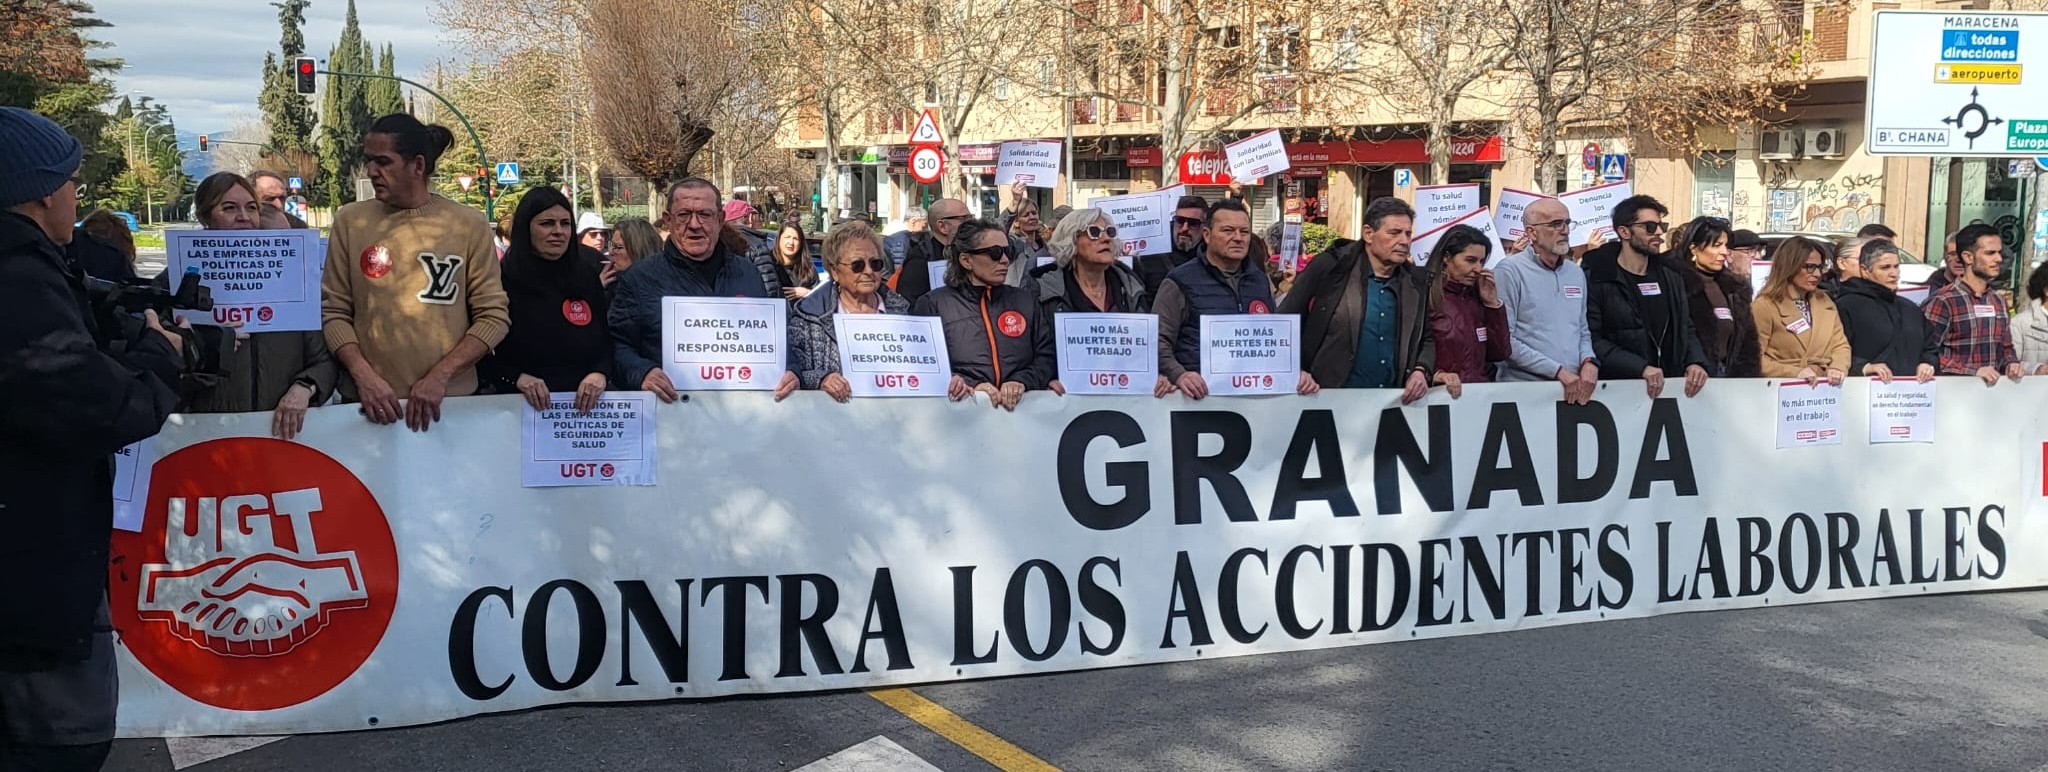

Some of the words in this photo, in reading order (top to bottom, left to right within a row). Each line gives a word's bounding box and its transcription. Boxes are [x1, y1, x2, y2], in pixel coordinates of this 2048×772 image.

[1944, 17, 2019, 28] MARACENA
[1971, 34, 2006, 45] todas
[1943, 47, 2015, 59] direcciones
[1951, 69, 2019, 80] aeropuerto
[2015, 121, 2048, 134] Plaza
[1898, 131, 1946, 143] CHANA
[1009, 150, 1049, 158] Solidaridad
[1237, 141, 1272, 158] Solidaridad
[1256, 148, 1282, 160] familias
[918, 158, 936, 170] 30
[1026, 160, 1056, 168] familias
[1188, 154, 1231, 183] telepiz
[1398, 172, 1408, 184] P
[1442, 192, 1462, 200] salud
[1579, 192, 1612, 204] Denuncia
[1112, 205, 1148, 215] DENUNCIA
[1440, 204, 1456, 212] está
[1118, 218, 1160, 228] MPLIMIENTO
[192, 238, 270, 248] REGULACIÓN
[274, 238, 290, 246] EN
[1122, 240, 1138, 252] GT
[188, 250, 210, 258] LAS
[214, 250, 277, 258] EMPRESAS
[282, 249, 296, 257] DE
[202, 259, 264, 270] POLÍTICAS
[268, 260, 284, 268] DE
[203, 271, 271, 280] SEGURIDAD
[276, 270, 282, 278] Y
[224, 282, 263, 291] SALUD
[213, 307, 254, 324] UGT
[684, 318, 734, 328] CARCEL
[738, 320, 768, 328] PARA
[1090, 326, 1106, 334] NO
[1108, 324, 1129, 334] MÁS
[1234, 328, 1250, 336] NO
[1253, 326, 1274, 336] MÁS
[716, 332, 740, 340] LOS
[854, 333, 897, 342] CARCEL
[900, 334, 927, 344] PARA
[1068, 336, 1118, 345] MUERTES
[1120, 337, 1132, 345] EN
[1136, 338, 1147, 346] EL
[677, 343, 774, 353] RESPONSABLES
[882, 344, 904, 352] LOS
[1212, 339, 1261, 348] MUERTES
[1264, 339, 1276, 347] EN
[1280, 338, 1290, 346] EL
[1086, 346, 1132, 356] TRABAJO
[1229, 349, 1276, 358] TRABAJO
[852, 354, 936, 364] RESPONSABLES
[701, 366, 736, 380] UGT
[875, 374, 904, 388] UGT
[1090, 373, 1116, 386] UGT
[1232, 376, 1260, 388] UGT
[548, 402, 614, 410] REGUIÓN
[618, 402, 631, 410] EN
[1782, 400, 1790, 408] No
[1792, 398, 1805, 407] más
[1806, 398, 1836, 406] muertes
[542, 412, 561, 420] LAS
[1796, 412, 1802, 420] el
[1804, 410, 1830, 422] trabajo
[554, 420, 608, 429] POLÍTICAS
[554, 431, 614, 439] SEGURIDAD
[1057, 398, 1699, 531] GRANADA
[560, 464, 597, 478] UGT
[165, 487, 323, 565] UGT
[448, 567, 915, 701] CONTRA
[947, 555, 1128, 667] LOS
[1159, 523, 1634, 649] ACCIDENTES
[1655, 504, 2007, 604] LABORALES
